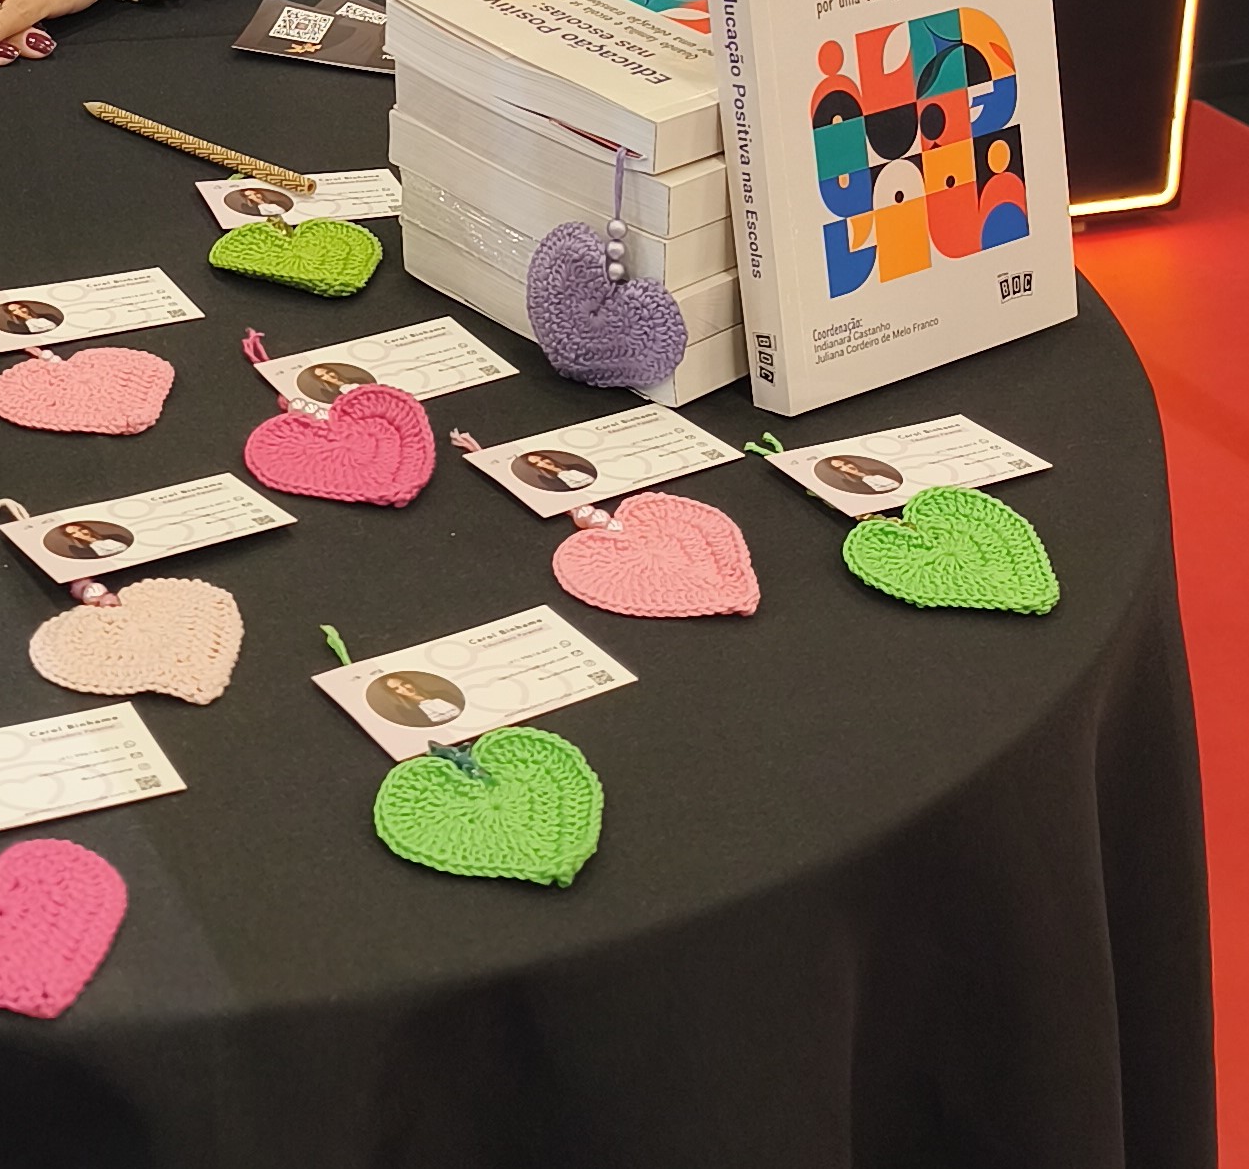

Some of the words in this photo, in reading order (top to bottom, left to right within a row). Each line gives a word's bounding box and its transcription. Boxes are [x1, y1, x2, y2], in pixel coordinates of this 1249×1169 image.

[532, 1, 615, 40] escolas:
[560, 32, 673, 86] Educação
[613, 39, 657, 59] nas
[732, 83, 753, 166] Positiva
[741, 171, 754, 205] nas
[745, 209, 763, 280] Escolas
[999, 272, 1033, 300] BOC
[812, 317, 864, 342] Coordenação:
[815, 349, 845, 365] Juliana
[845, 337, 880, 354] Cordeiro
[880, 333, 891, 344] de
[892, 326, 912, 339] Melo
[912, 317, 939, 333] Franco
[853, 322, 891, 341] Castanho
[755, 334, 774, 384] BOC
